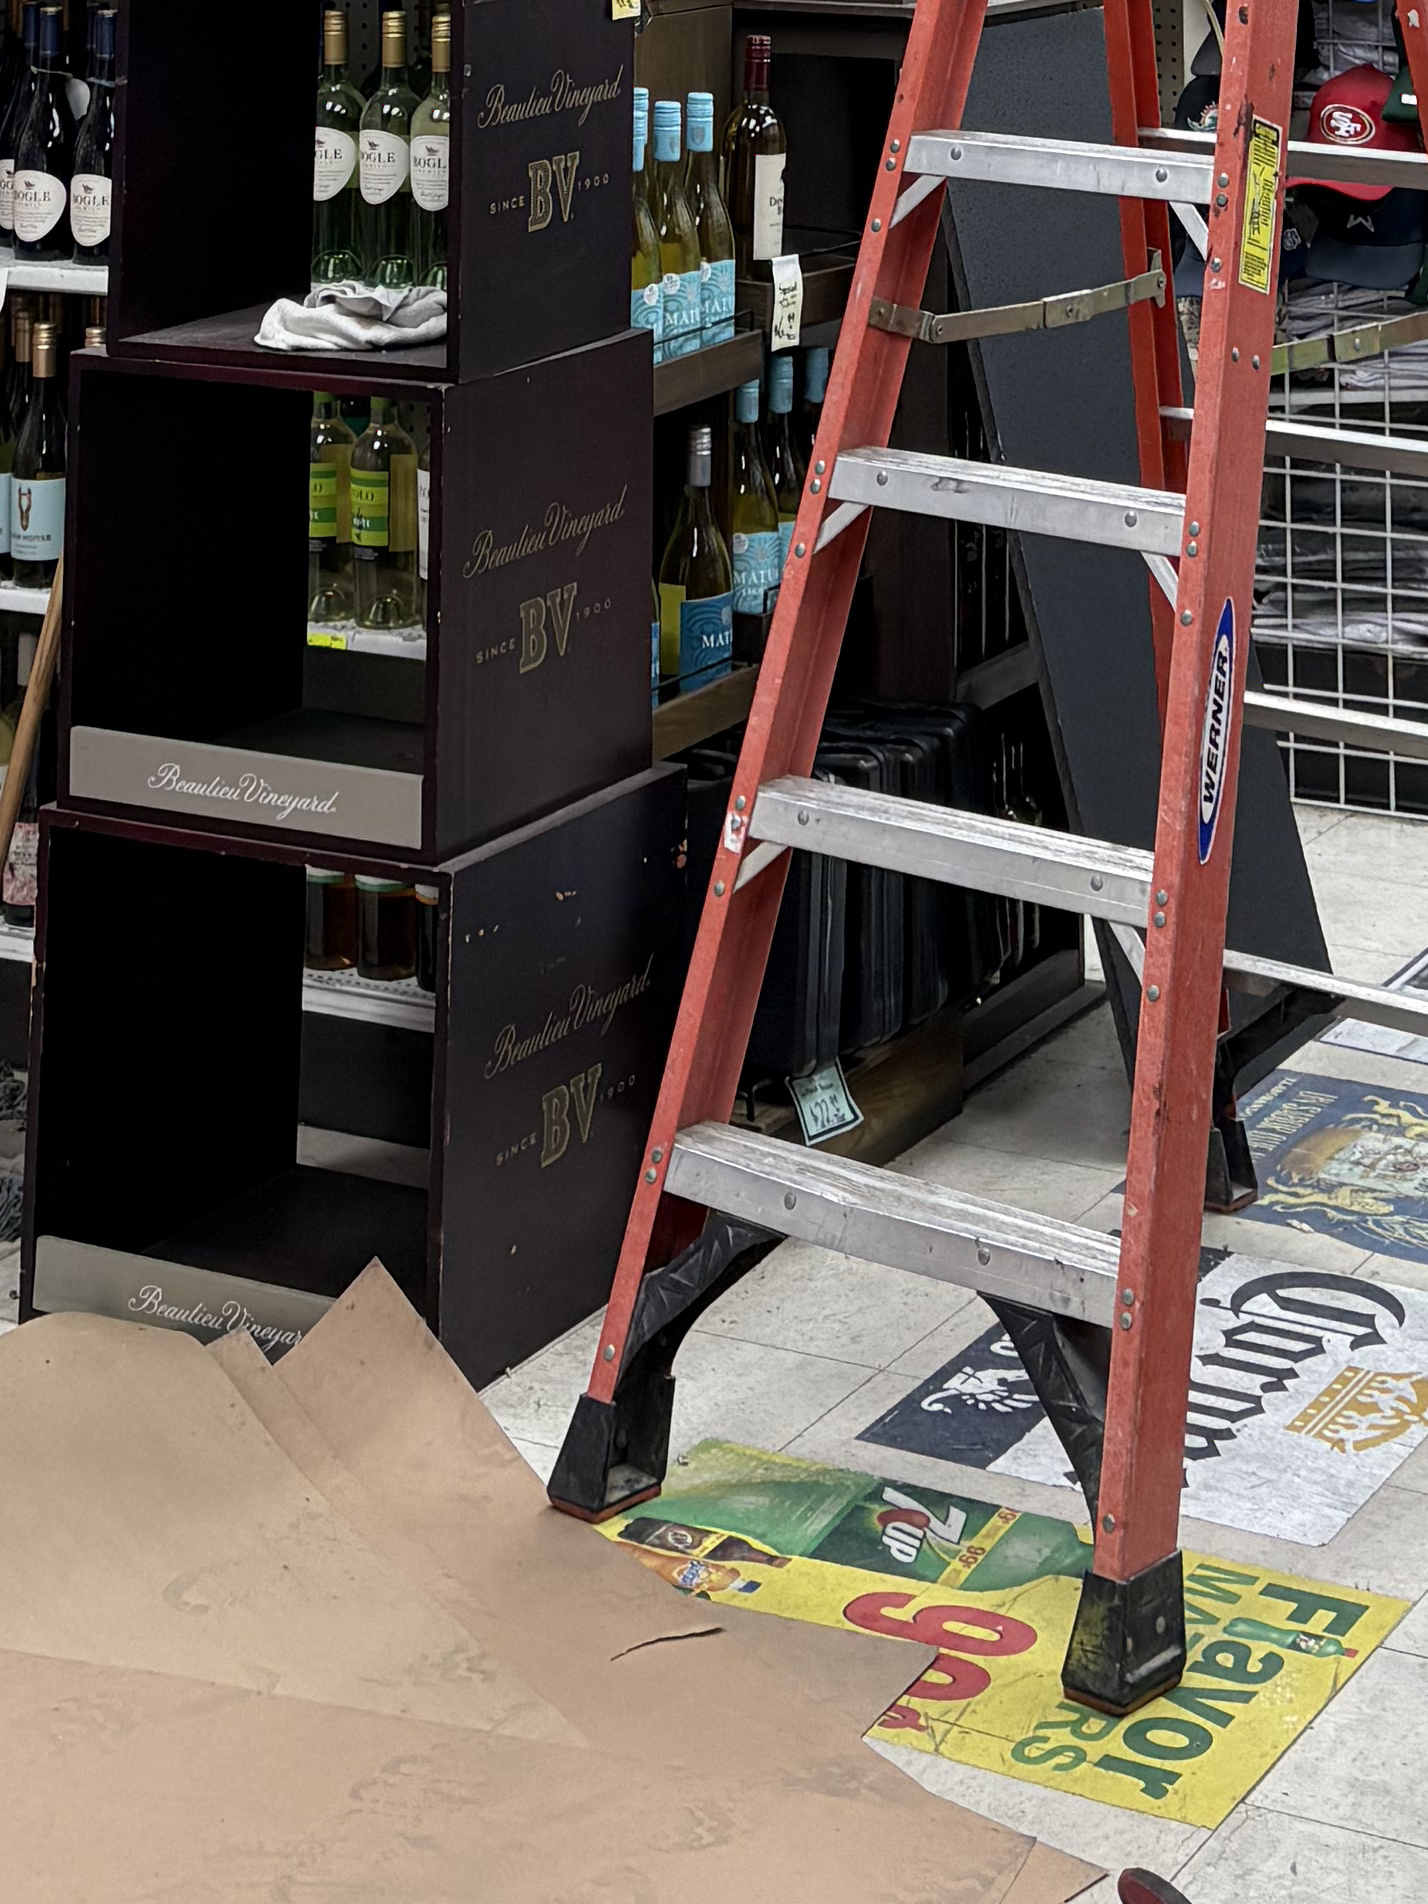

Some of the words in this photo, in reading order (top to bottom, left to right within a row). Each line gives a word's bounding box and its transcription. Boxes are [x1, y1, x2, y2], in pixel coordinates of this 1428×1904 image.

[477, 82, 553, 129] Beaulieu
[551, 64, 624, 126] Vineyard
[414, 156, 447, 168] BOGL
[490, 195, 525, 214] SINCE
[527, 151, 580, 233] BV
[577, 173, 610, 191] 1900
[463, 524, 547, 579] Beaulieu
[544, 484, 628, 557] Vineyard
[476, 638, 516, 664] SINCE
[520, 582, 577, 674] BV
[576, 598, 612, 622] 1900
[702, 632, 732, 648] MAT
[1204, 650, 1228, 803] WERNER
[147, 762, 241, 801] Beaulieu
[239, 773, 339, 821] Vineyard
[484, 1012, 570, 1079] Beaulieu
[569, 952, 654, 1037] Vineyard
[496, 1132, 537, 1166] SINCE
[540, 1063, 602, 1168] BV
[600, 1074, 635, 1101] 1900
[128, 1285, 223, 1330] Beaulieu
[222, 1300, 302, 1352] Vineyar
